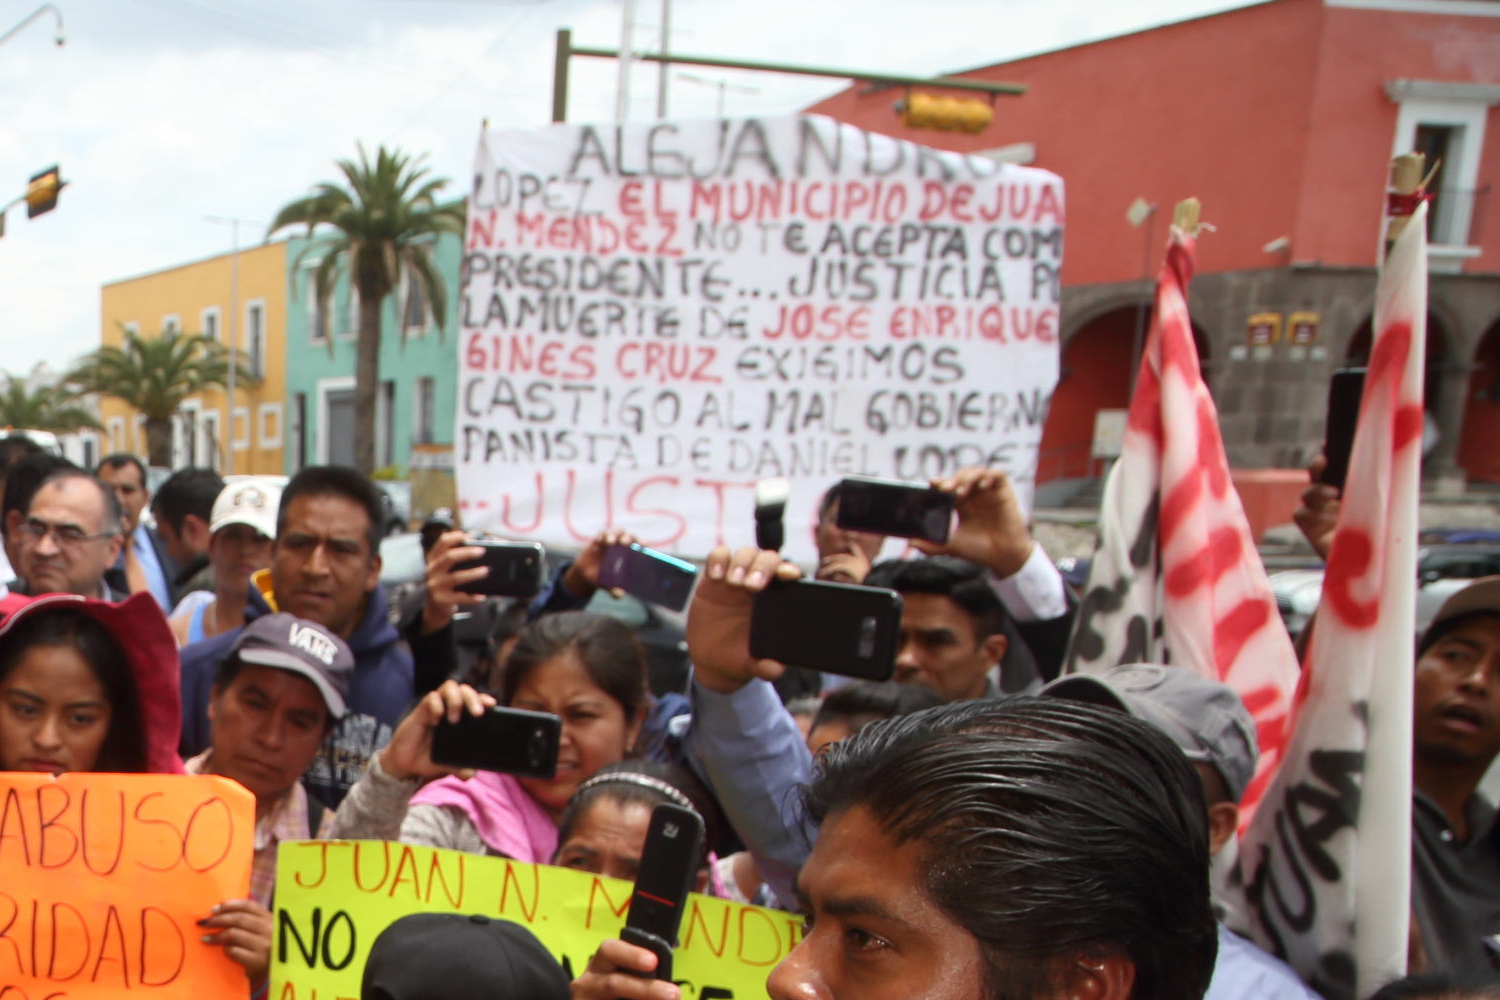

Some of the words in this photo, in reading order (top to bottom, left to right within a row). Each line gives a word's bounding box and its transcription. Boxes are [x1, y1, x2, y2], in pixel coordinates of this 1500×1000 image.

[472, 168, 603, 217] LOPEZ
[618, 180, 679, 219] EL
[689, 179, 907, 223] MUNICIPIO
[513, 212, 685, 257] MENDEZ
[694, 222, 742, 251] NO
[755, 222, 809, 255] TE
[820, 222, 968, 261] ACEPTA
[982, 226, 1064, 260] COM
[788, 256, 1005, 302] JUSTICIA
[699, 306, 751, 340] DE
[761, 303, 873, 341] JOSE
[888, 304, 1058, 344] ENRIQUE
[615, 342, 723, 385] CRUZ
[735, 341, 965, 385] EXIGIMOS
[463, 377, 681, 434] CASTIGO
[695, 390, 751, 432] AL
[763, 390, 850, 436] MAL
[462, 425, 639, 471] PANISTA
[657, 434, 712, 473] DE
[728, 437, 880, 479] DANIEL
[288, 622, 339, 666] VANS
[294, 839, 465, 910] JUAN
[277, 907, 357, 971] NO
